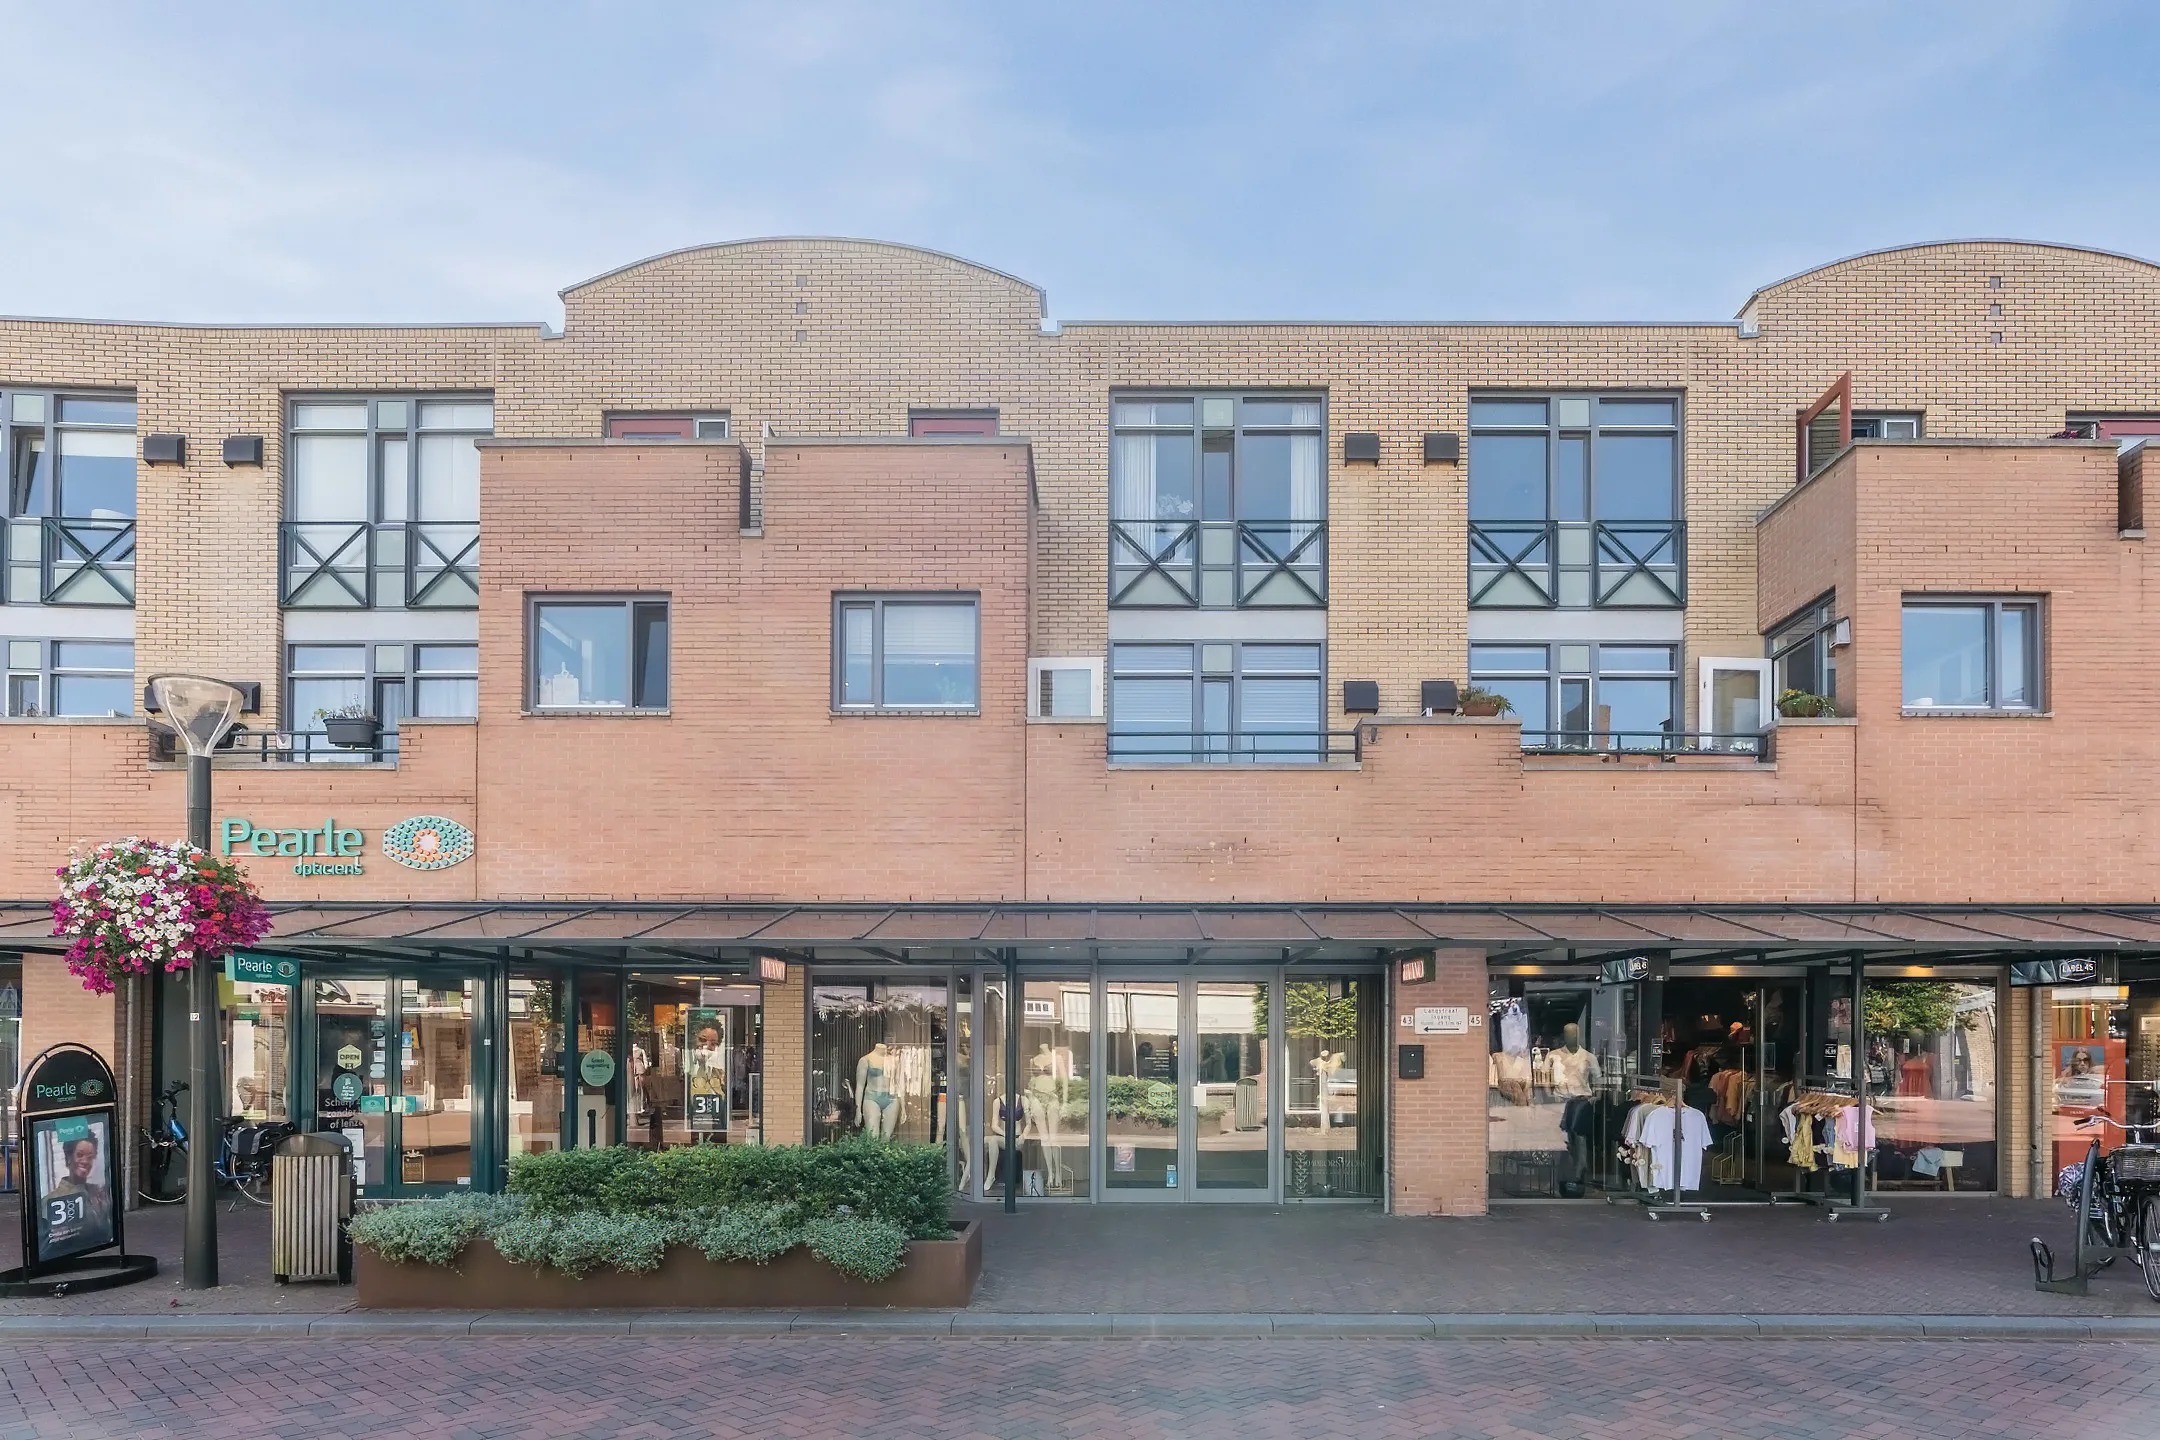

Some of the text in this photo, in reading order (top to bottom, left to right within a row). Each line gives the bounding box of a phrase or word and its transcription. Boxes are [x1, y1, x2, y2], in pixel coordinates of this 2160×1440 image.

[221, 817, 364, 857] Pearle
[293, 861, 364, 877] opticiens
[237, 957, 273, 973] Pearle
[1402, 1016, 1413, 1025] 43
[1470, 1016, 1481, 1025] 45
[36, 1082, 77, 1099] Pearle
[695, 1096, 706, 1114] 3
[712, 1096, 720, 1113] 1
[50, 1200, 67, 1226] 3
[74, 1196, 84, 1219] 1
